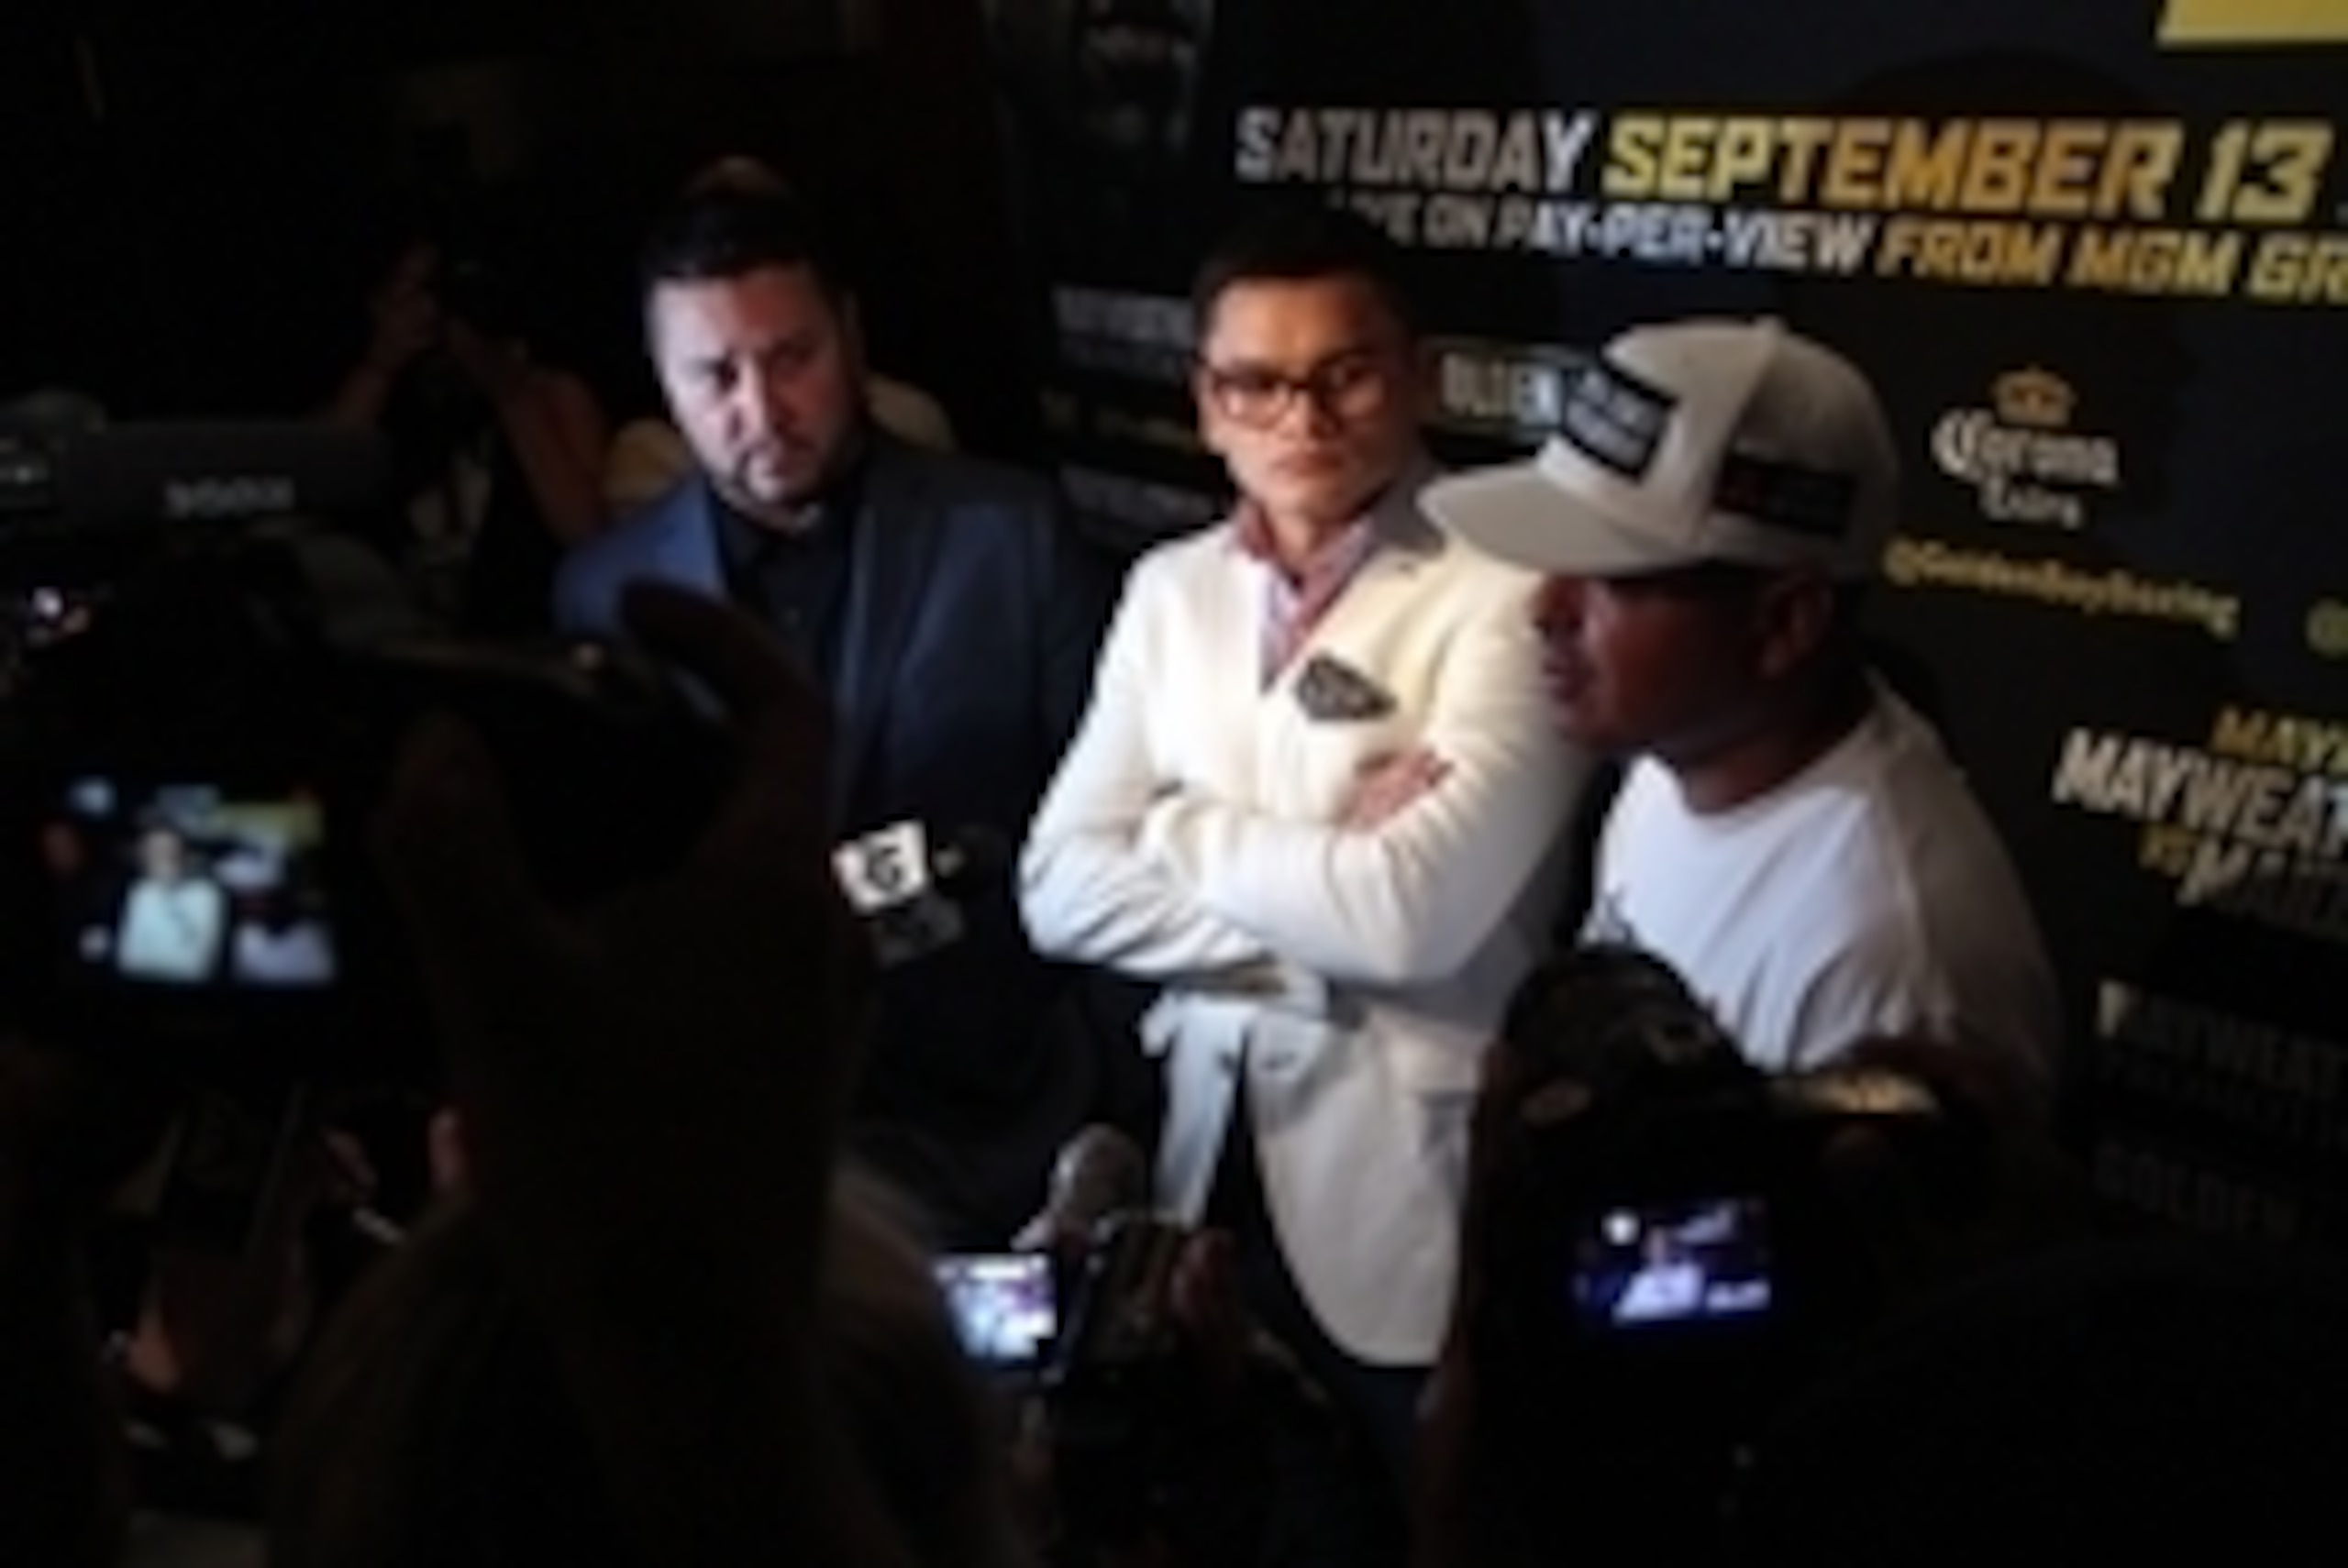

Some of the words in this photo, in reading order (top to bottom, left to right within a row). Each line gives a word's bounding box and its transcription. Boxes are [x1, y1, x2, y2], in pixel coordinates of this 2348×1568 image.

[1234, 104, 1597, 194] SATURDAY
[1600, 106, 2187, 221] SEPTEMBER
[2192, 114, 2339, 224] 13
[1871, 213, 2066, 290] FROM
[2062, 225, 2241, 301] MGM
